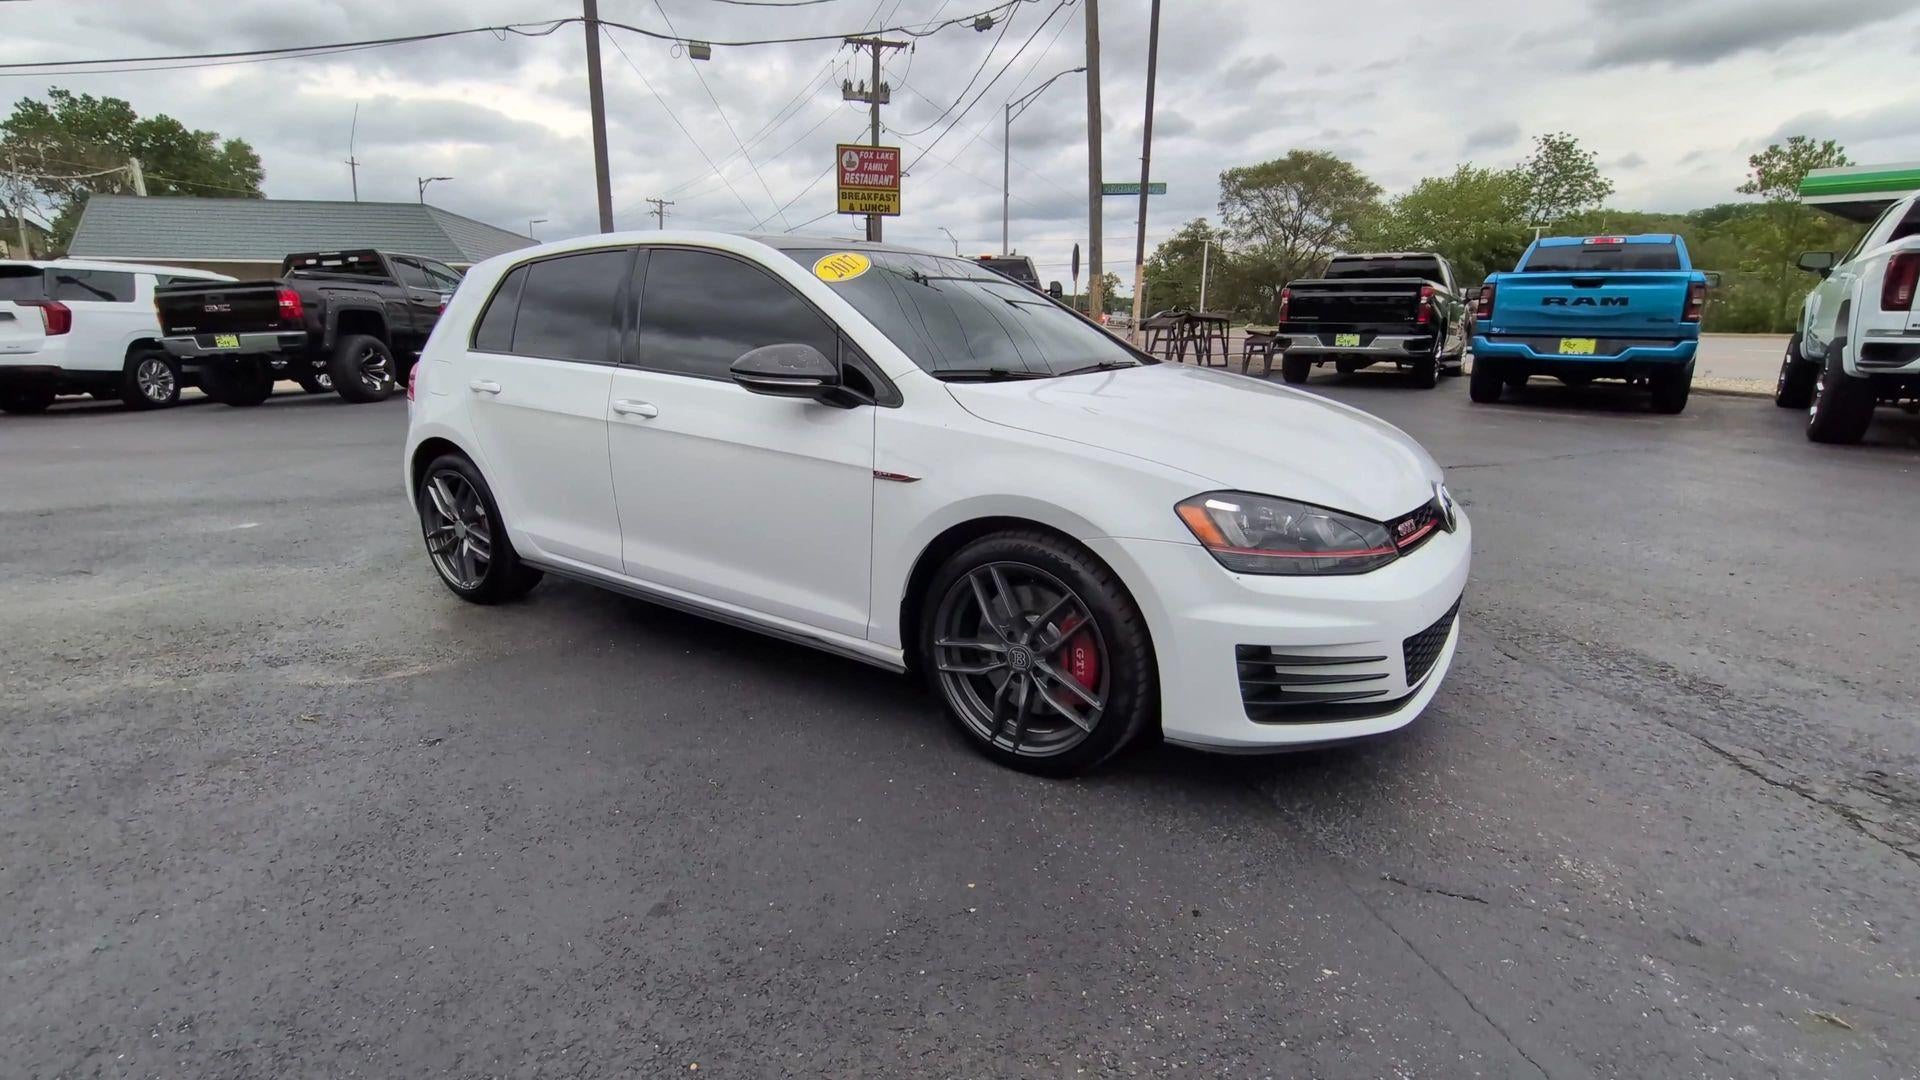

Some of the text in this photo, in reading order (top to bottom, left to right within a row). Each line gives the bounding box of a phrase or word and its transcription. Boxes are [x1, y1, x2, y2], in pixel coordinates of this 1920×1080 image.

[859, 151, 895, 161] FOX LAKE
[863, 162, 889, 172] FAMILY
[844, 173, 894, 186] RESTAURANT
[841, 191, 897, 202] BREAKFAST
[848, 203, 891, 213] & LUNCH
[823, 254, 861, 279] 2017
[1541, 296, 1630, 307] RAM
[1075, 647, 1085, 677] GTI
